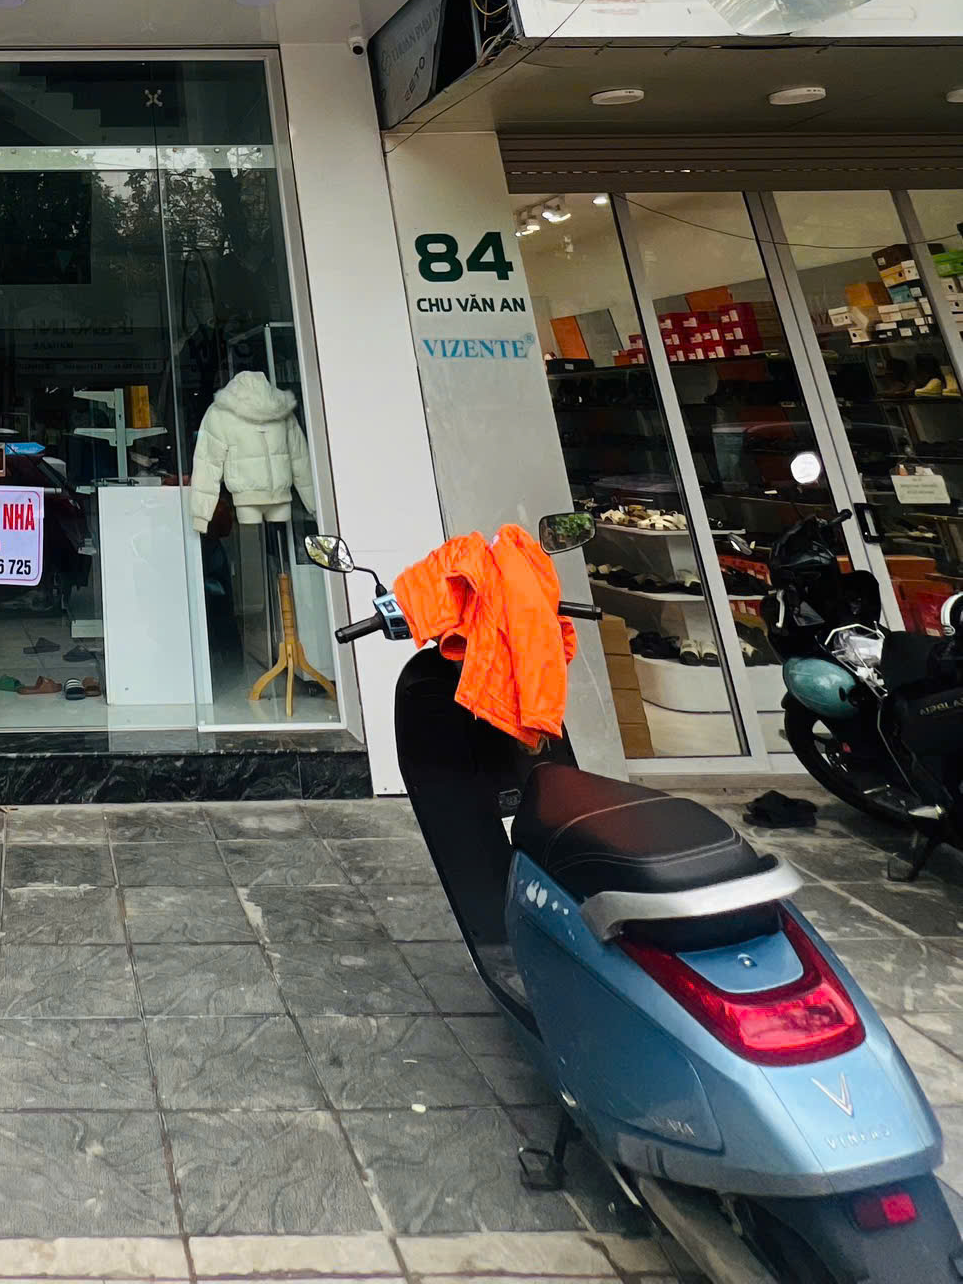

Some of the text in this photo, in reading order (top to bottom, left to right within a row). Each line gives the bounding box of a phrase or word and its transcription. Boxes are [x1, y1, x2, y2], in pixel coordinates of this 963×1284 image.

[415, 232, 514, 282] 84
[416, 294, 526, 312] CHU VĂN AN
[422, 339, 528, 358] VIZENTE
[3, 498, 35, 530] NHÀ
[9, 559, 31, 575] 725
